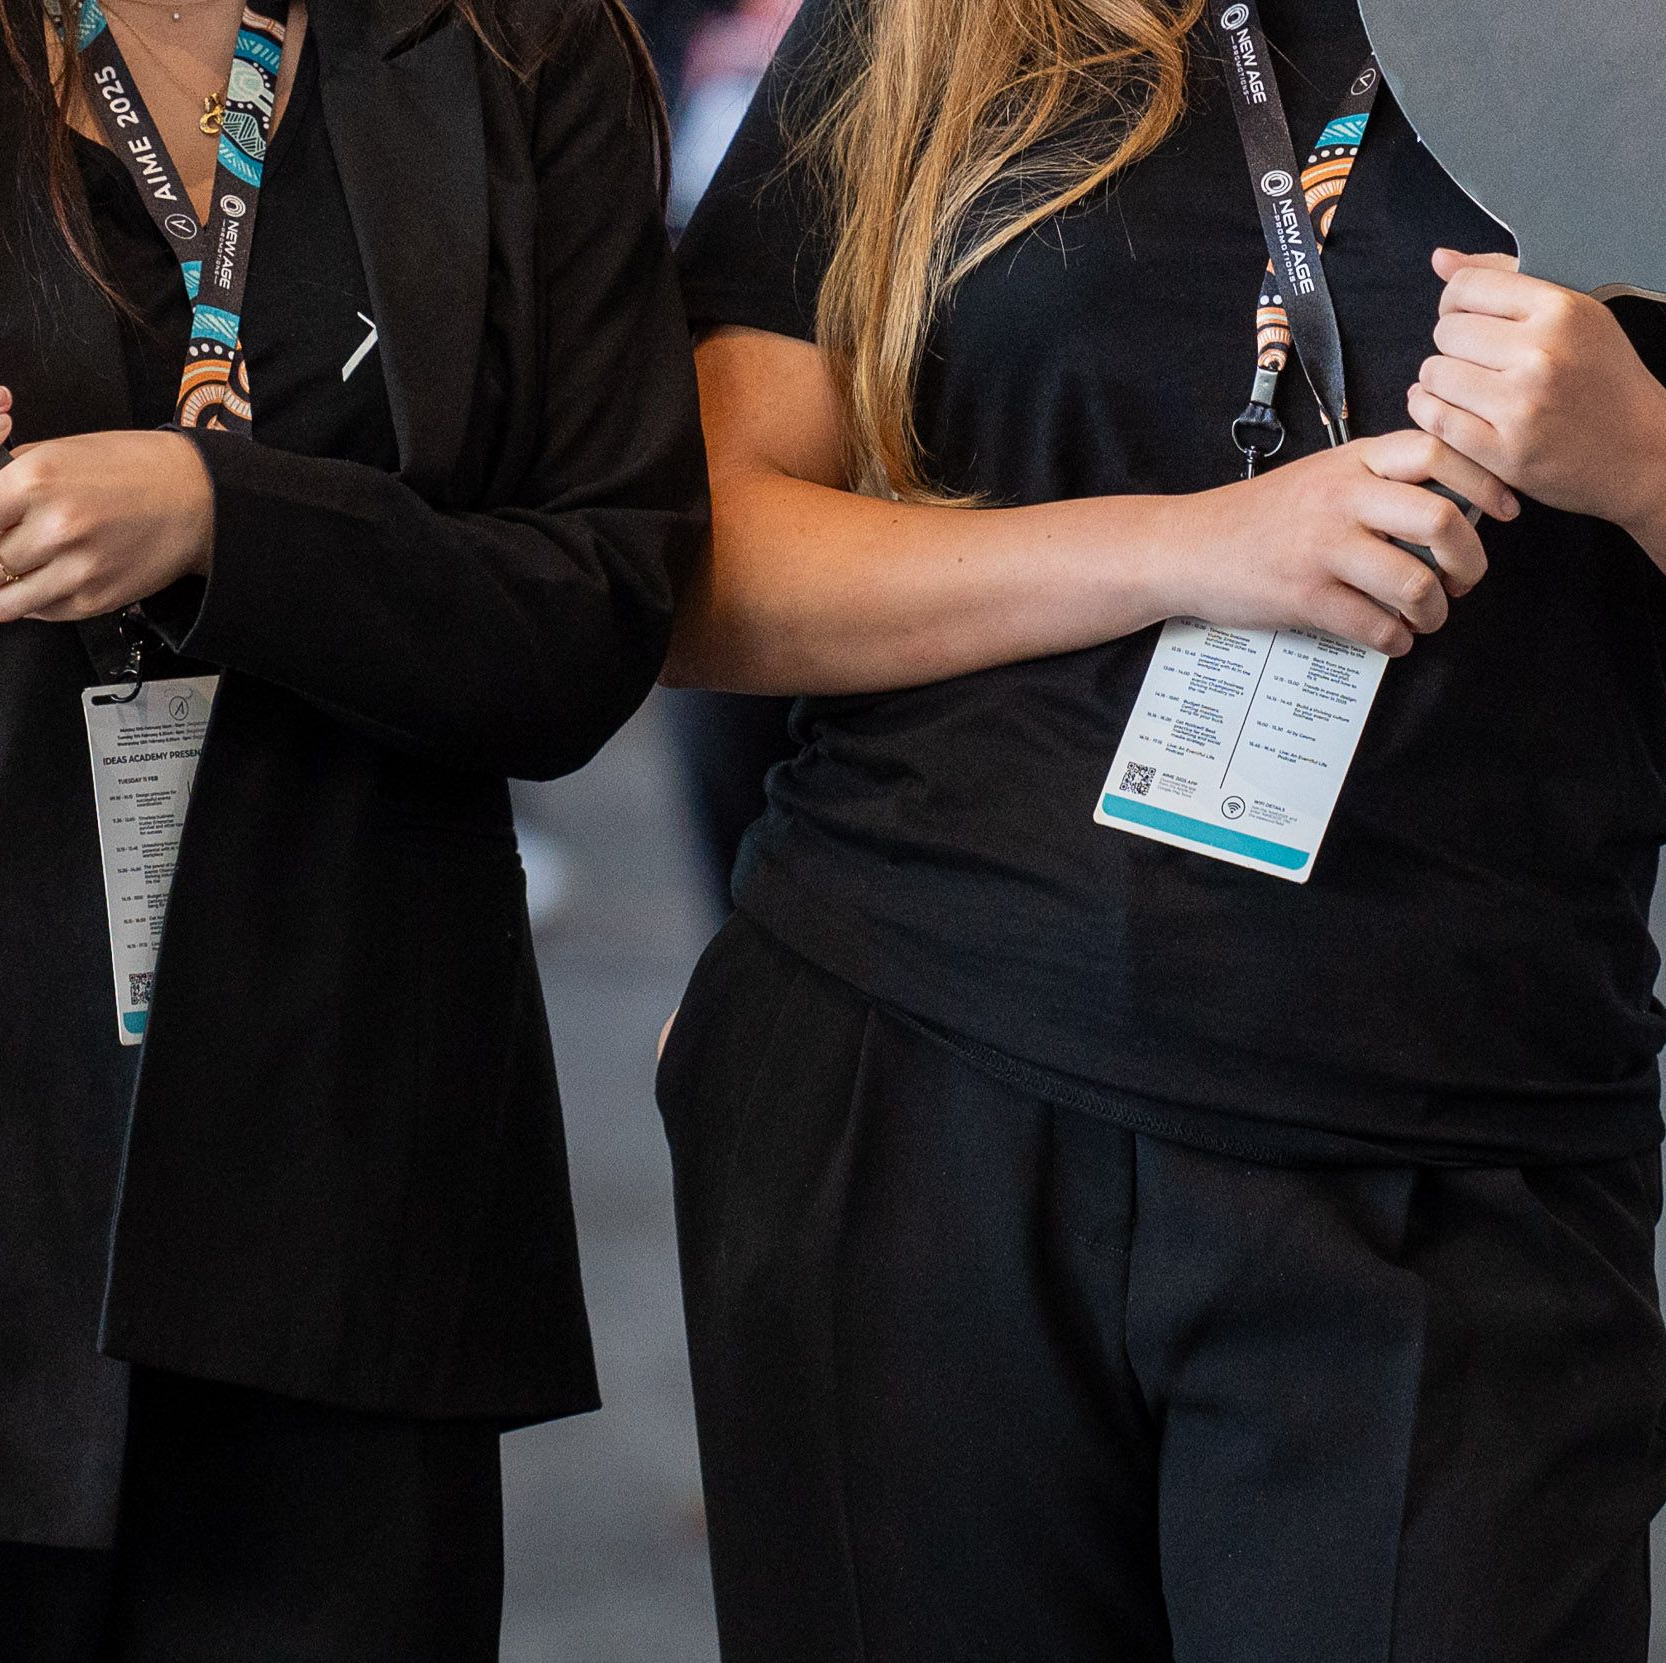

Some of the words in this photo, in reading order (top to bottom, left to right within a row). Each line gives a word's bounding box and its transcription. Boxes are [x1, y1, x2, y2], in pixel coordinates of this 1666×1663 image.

[1236, 28, 1258, 67] NEW
[94, 65, 140, 129] 2025
[1245, 70, 1267, 104] AGE
[128, 136, 178, 201] AIME
[224, 219, 240, 257] NEW
[1274, 215, 1296, 283] PROMOTIONS
[1279, 198, 1303, 245] NEW
[1291, 249, 1315, 295] AGE
[219, 256, 233, 290] AGE
[102, 755, 127, 765] IDEAS
[128, 751, 167, 763] ACADEMY
